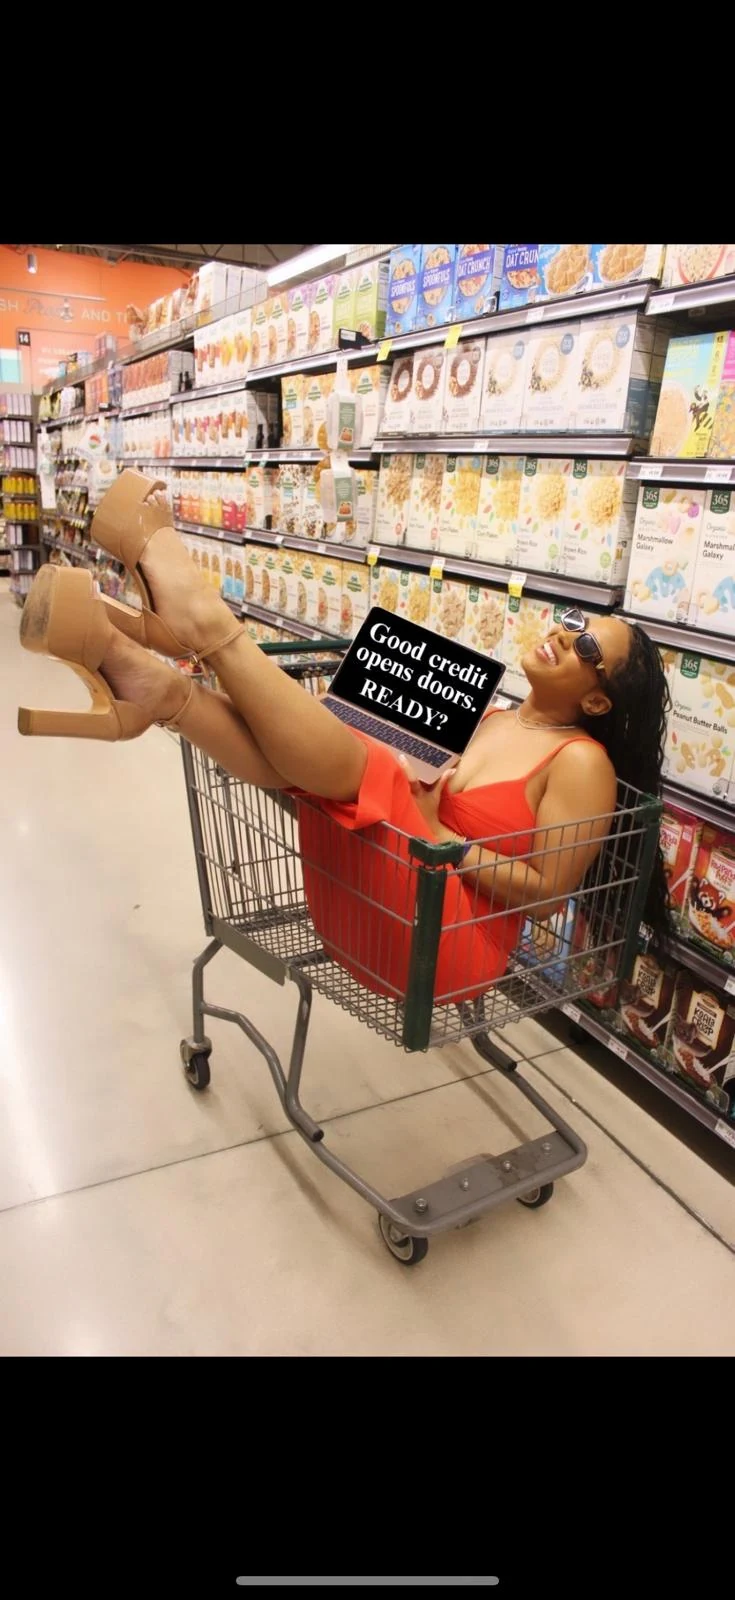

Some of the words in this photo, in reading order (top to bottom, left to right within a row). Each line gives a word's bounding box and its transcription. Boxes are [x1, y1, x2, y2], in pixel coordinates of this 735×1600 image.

[505, 253, 519, 268] OAT
[81, 309, 110, 322] AND
[19, 334, 29, 343] 14
[574, 463, 587, 473] 365
[643, 490, 658, 502] 365
[712, 494, 729, 506] 365
[637, 533, 674, 545] Marshmallow
[636, 542, 654, 552] Galaxy
[702, 549, 724, 561] Galaxy
[369, 622, 427, 661] Good
[428, 663, 489, 690] credit
[682, 658, 699, 672] 365
[356, 646, 414, 682] opens
[417, 671, 477, 713] doors.
[358, 678, 449, 731] READY?
[673, 710, 693, 723] Peanut
[693, 714, 713, 729] Butter
[712, 723, 728, 735] Balls
